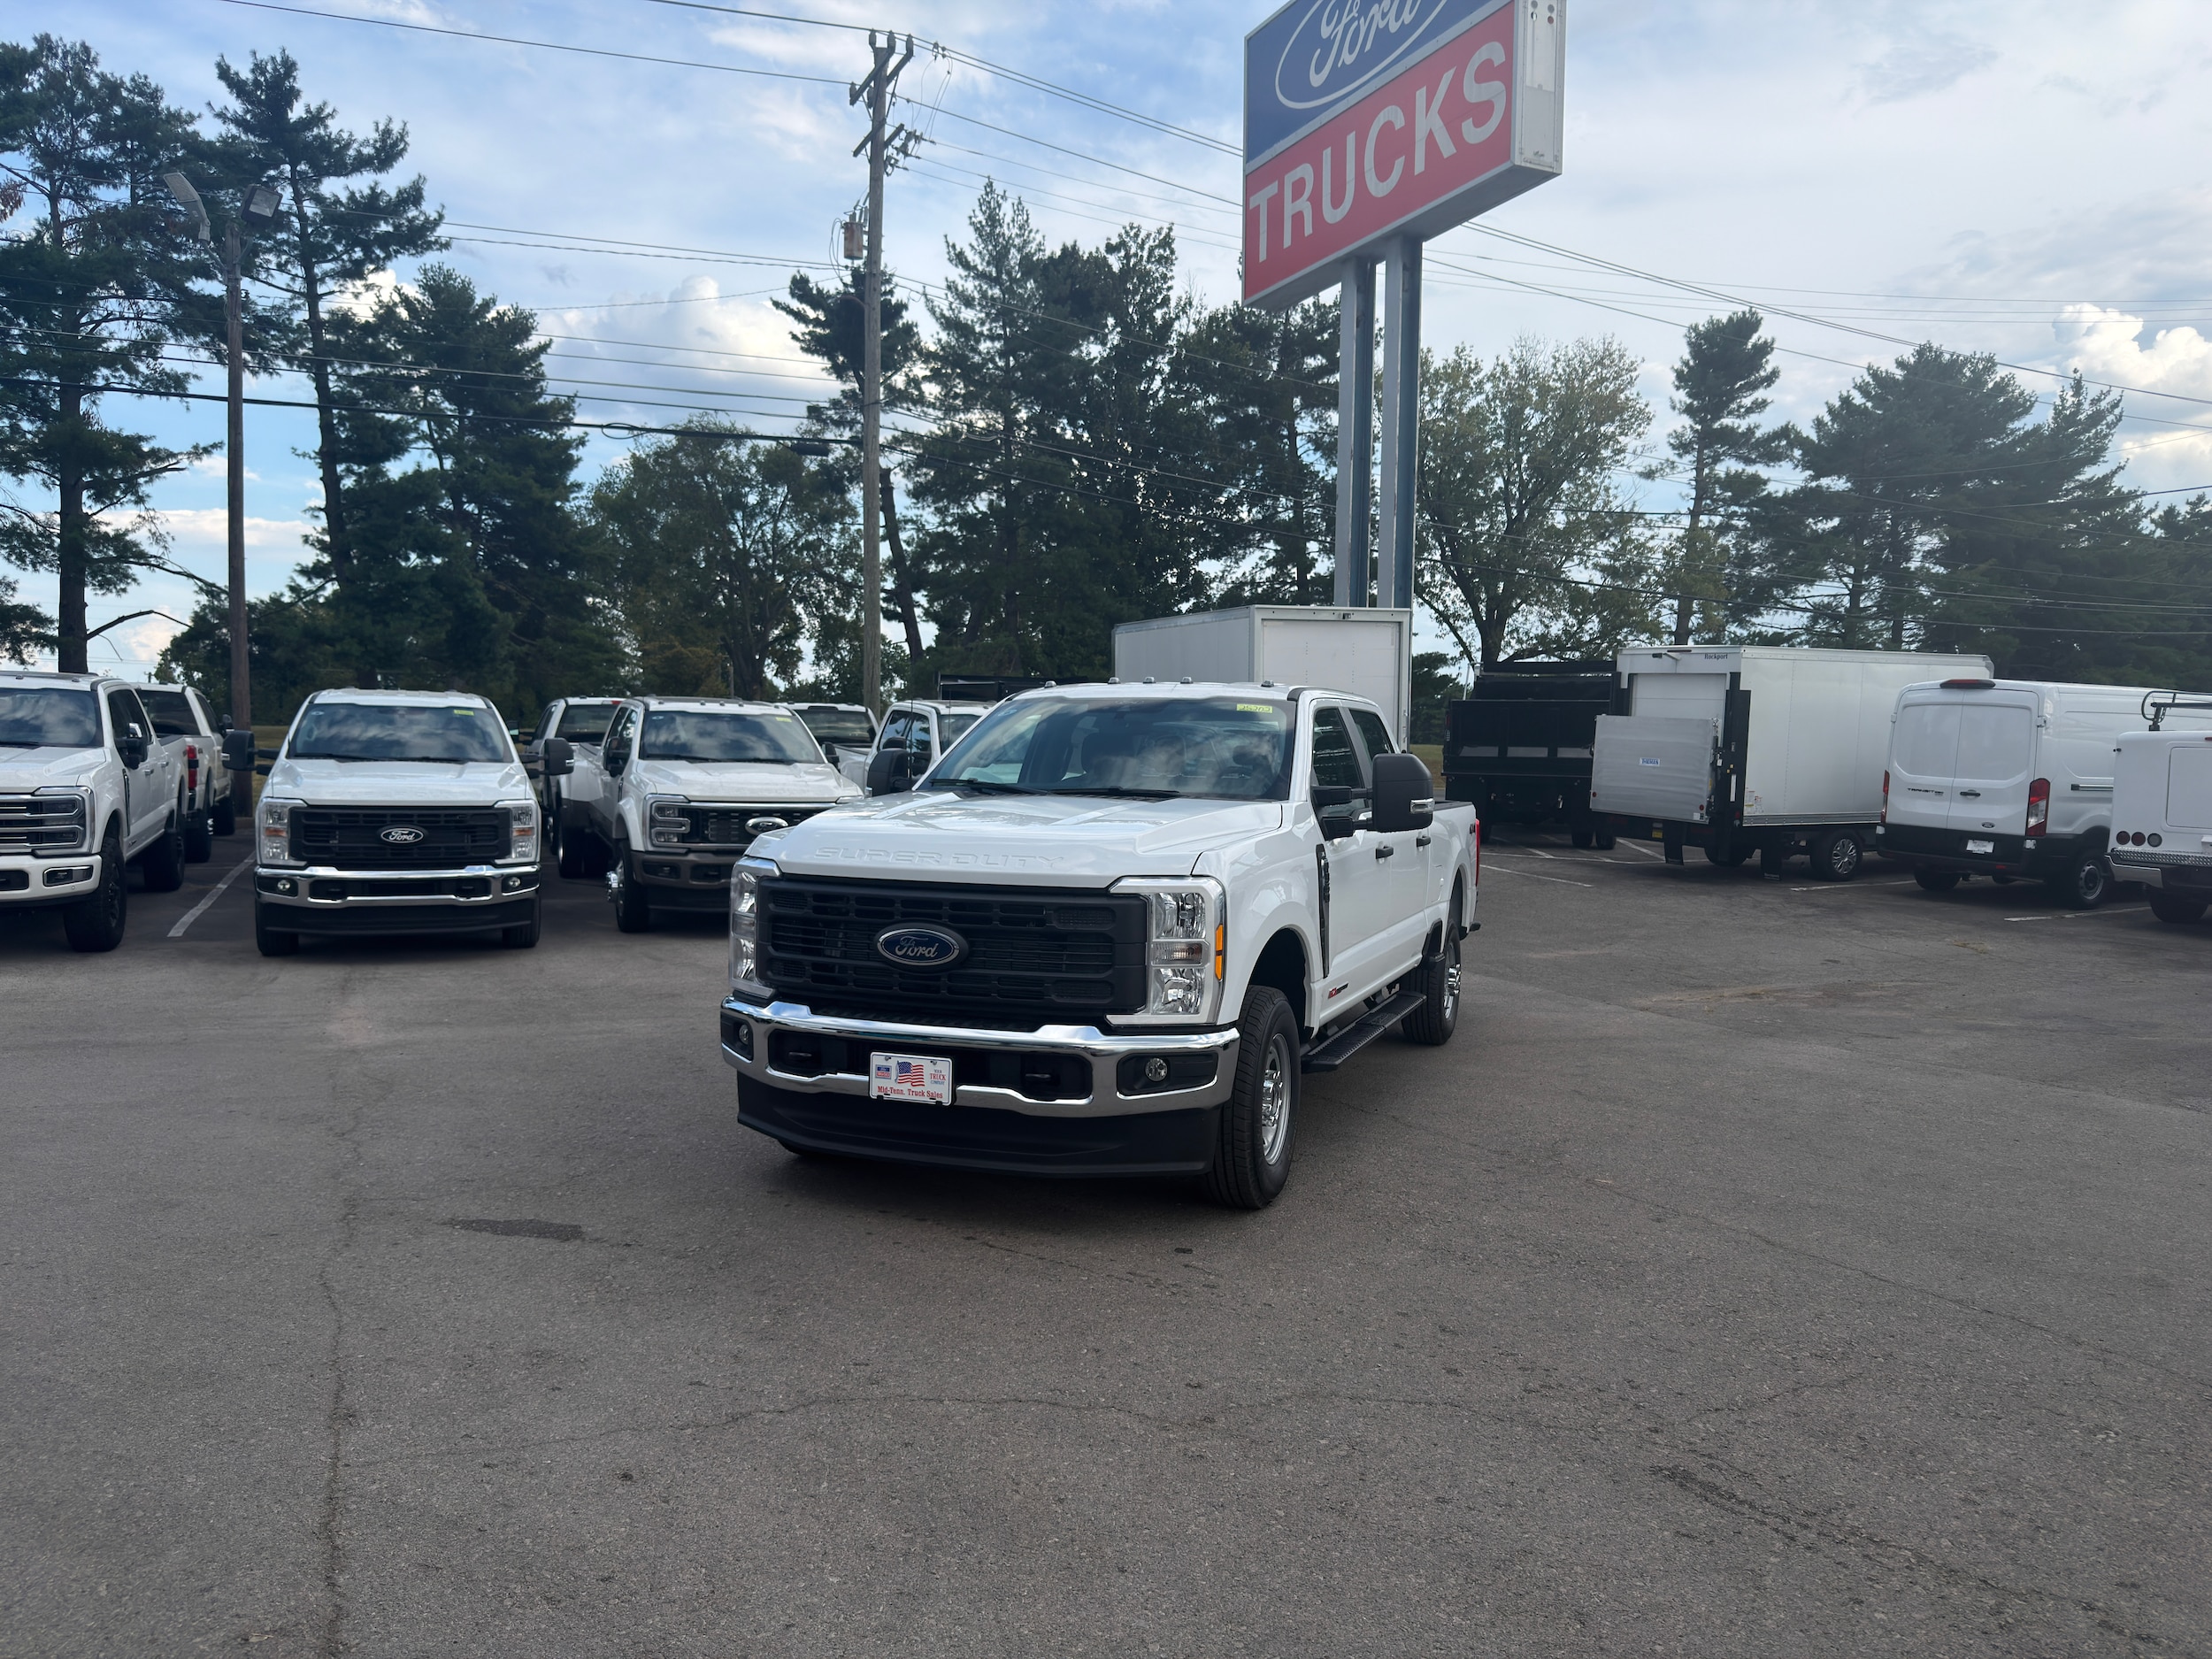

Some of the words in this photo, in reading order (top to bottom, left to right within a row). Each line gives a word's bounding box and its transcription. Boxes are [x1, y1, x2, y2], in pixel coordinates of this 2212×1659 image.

[1249, 42, 1506, 263] TRUCKS
[389, 830, 416, 841] Ford
[814, 847, 942, 864] SUPER
[951, 853, 1064, 868] DUTY
[895, 935, 939, 957] Ford
[877, 1086, 905, 1095] Mid-Tenn.
[907, 1088, 926, 1097] Truck
[926, 1090, 943, 1099] Sales
